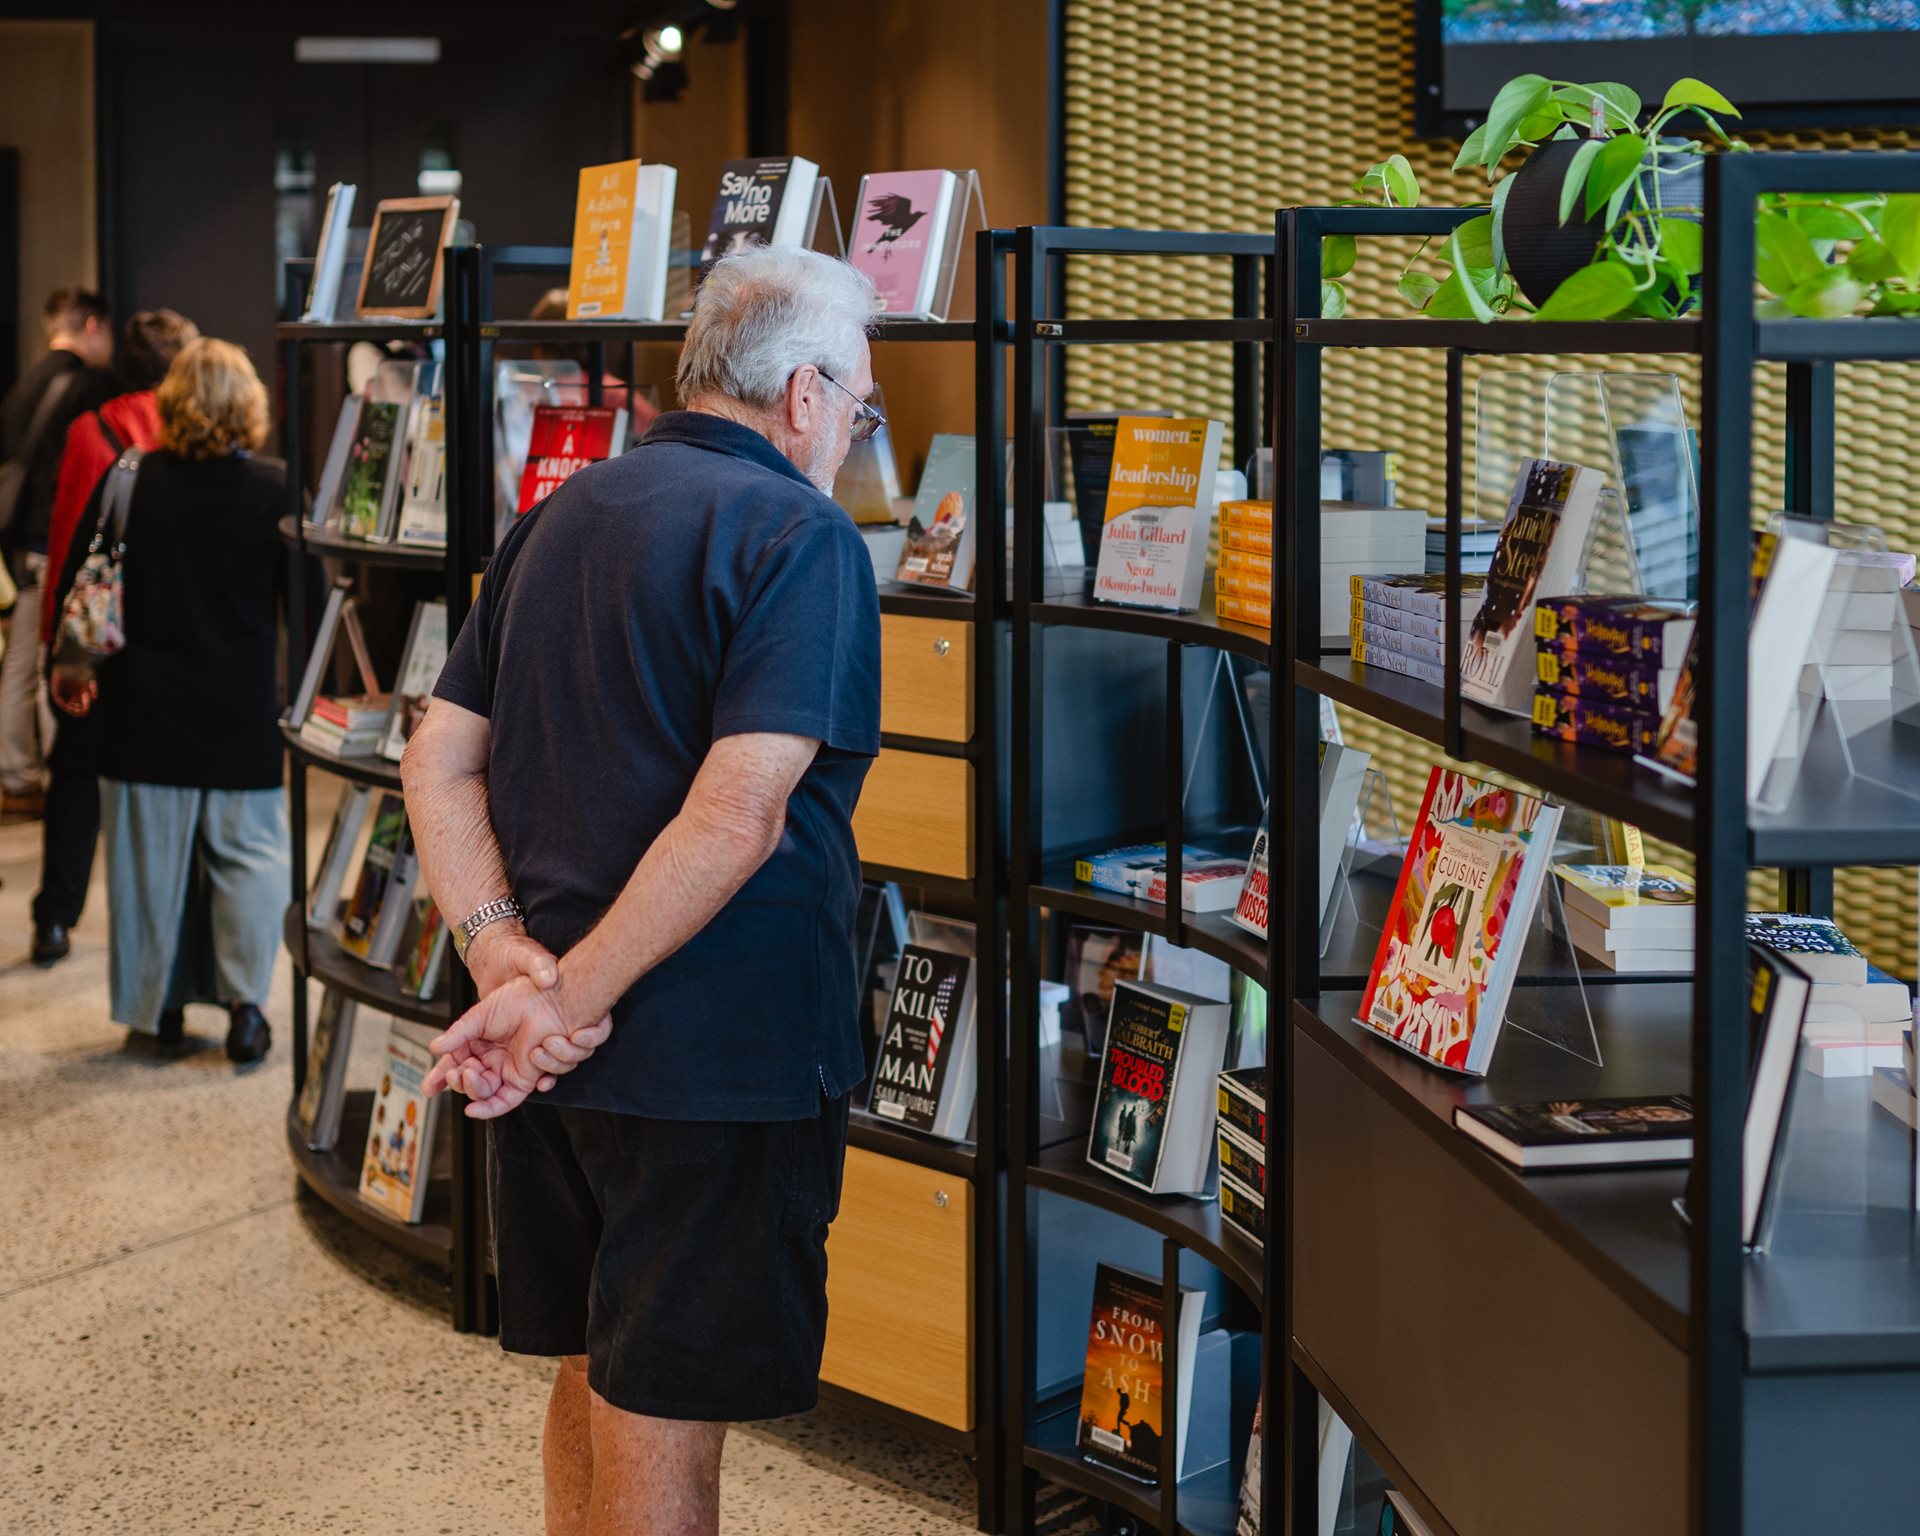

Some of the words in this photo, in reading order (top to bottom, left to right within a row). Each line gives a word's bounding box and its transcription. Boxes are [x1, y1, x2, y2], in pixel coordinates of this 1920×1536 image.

[599, 172, 621, 193] All
[720, 171, 755, 199] Say
[586, 193, 628, 214] Adults
[747, 184, 772, 205] no
[723, 201, 771, 224] More
[590, 217, 621, 234] Here
[884, 228, 903, 237] THE
[580, 277, 618, 298] Straub
[561, 434, 575, 455] A
[1133, 427, 1190, 445] women
[1146, 448, 1169, 464] and
[1114, 462, 1197, 493] leadership
[1107, 523, 1137, 541] Julia
[1140, 524, 1187, 545] Gillard
[1138, 548, 1147, 557] &
[1497, 534, 1543, 580] Steel
[1126, 561, 1156, 578] Ngozi
[1099, 575, 1177, 598] Okonjo-Iweala
[1363, 583, 1382, 602] nielle
[1382, 586, 1402, 608] Steel
[1363, 604, 1382, 624] nielle
[1382, 607, 1402, 630] Steel
[1411, 597, 1430, 614] ROYAL
[1363, 625, 1382, 646] nielle
[1382, 629, 1402, 652] Steel
[1411, 619, 1430, 635] ROYAL
[1365, 646, 1385, 667] nielle
[1386, 650, 1408, 674] Steel
[1411, 640, 1431, 657] ROYAL
[1416, 664, 1437, 680] ROYAL
[1459, 642, 1506, 688] ROYAL
[1444, 841, 1469, 862] Creative
[1469, 850, 1491, 871] Native
[1092, 864, 1113, 878] AMES
[1092, 873, 1121, 889] TERSON
[1438, 855, 1488, 890] CUISINE
[1798, 944, 1835, 952] ALL
[904, 954, 933, 984] TO
[893, 986, 937, 1021] KILL
[886, 1022, 903, 1048] A
[1129, 1022, 1161, 1039] ROBERT
[1113, 1029, 1174, 1061] GALBRAITH
[878, 1054, 936, 1093] MAN
[1111, 1047, 1165, 1082] TROUBLED
[1111, 1065, 1164, 1102] BLOOD
[875, 1084, 897, 1105] SAM
[897, 1092, 936, 1117] BOURNE
[1112, 1306, 1156, 1333] FROM
[1095, 1319, 1163, 1363] SNOW
[1119, 1353, 1139, 1372] TO
[1101, 1367, 1151, 1403] ASH
